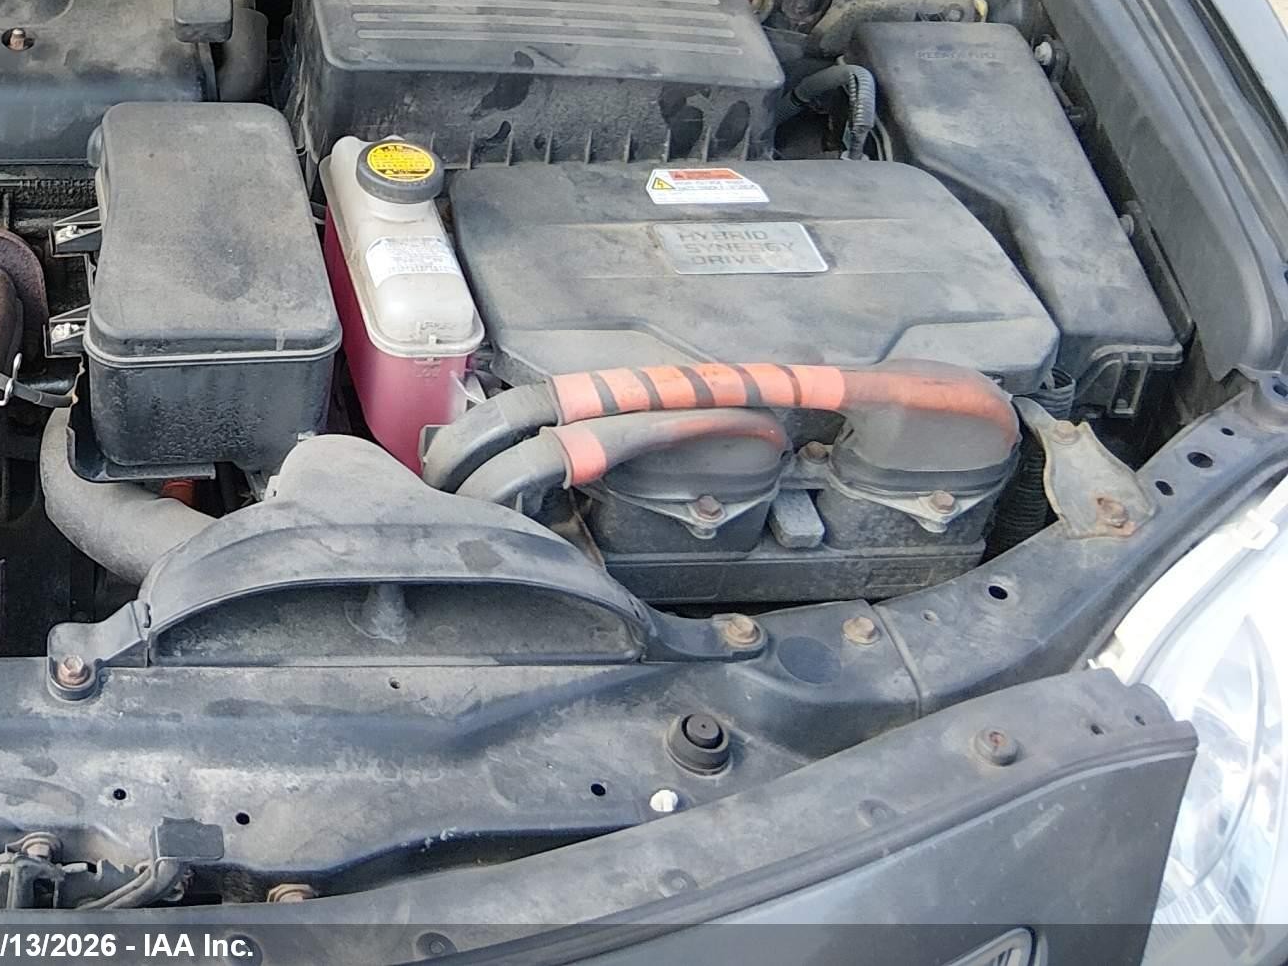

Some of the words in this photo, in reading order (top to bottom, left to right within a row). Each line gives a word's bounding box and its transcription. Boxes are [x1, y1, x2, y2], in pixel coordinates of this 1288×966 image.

[679, 229, 768, 242] HYBRID
[684, 242, 793, 253] SYNERGY
[692, 254, 762, 266] DRIVE
